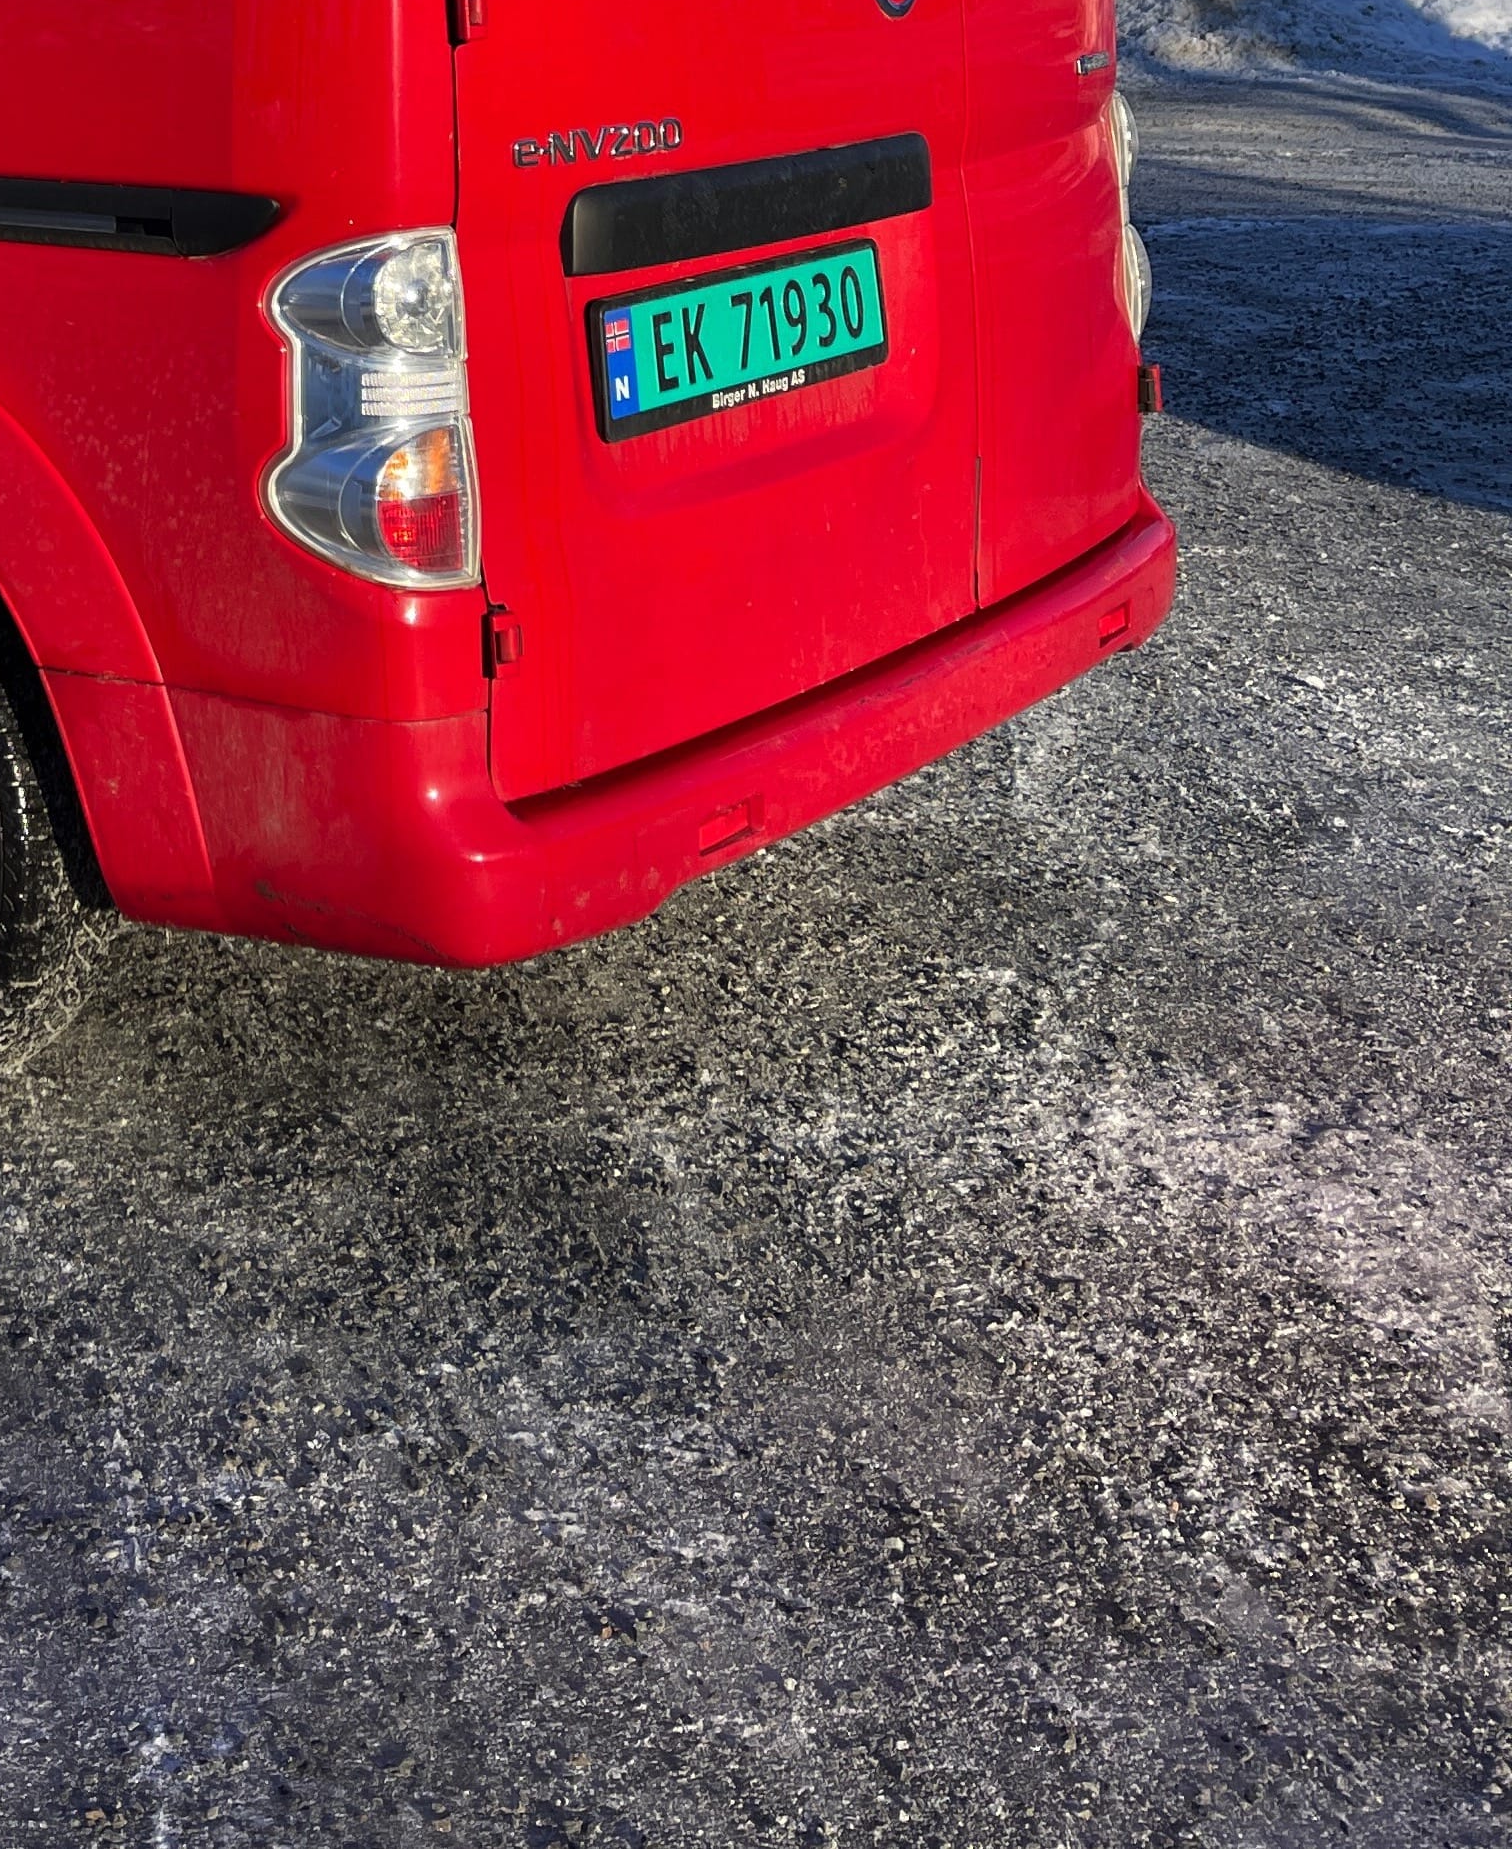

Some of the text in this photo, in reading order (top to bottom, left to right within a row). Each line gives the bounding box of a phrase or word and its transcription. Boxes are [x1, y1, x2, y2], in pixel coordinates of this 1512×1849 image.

[651, 264, 864, 393] EK 71930
[614, 374, 630, 401] N
[711, 368, 806, 409] Birger N. Haug AS
